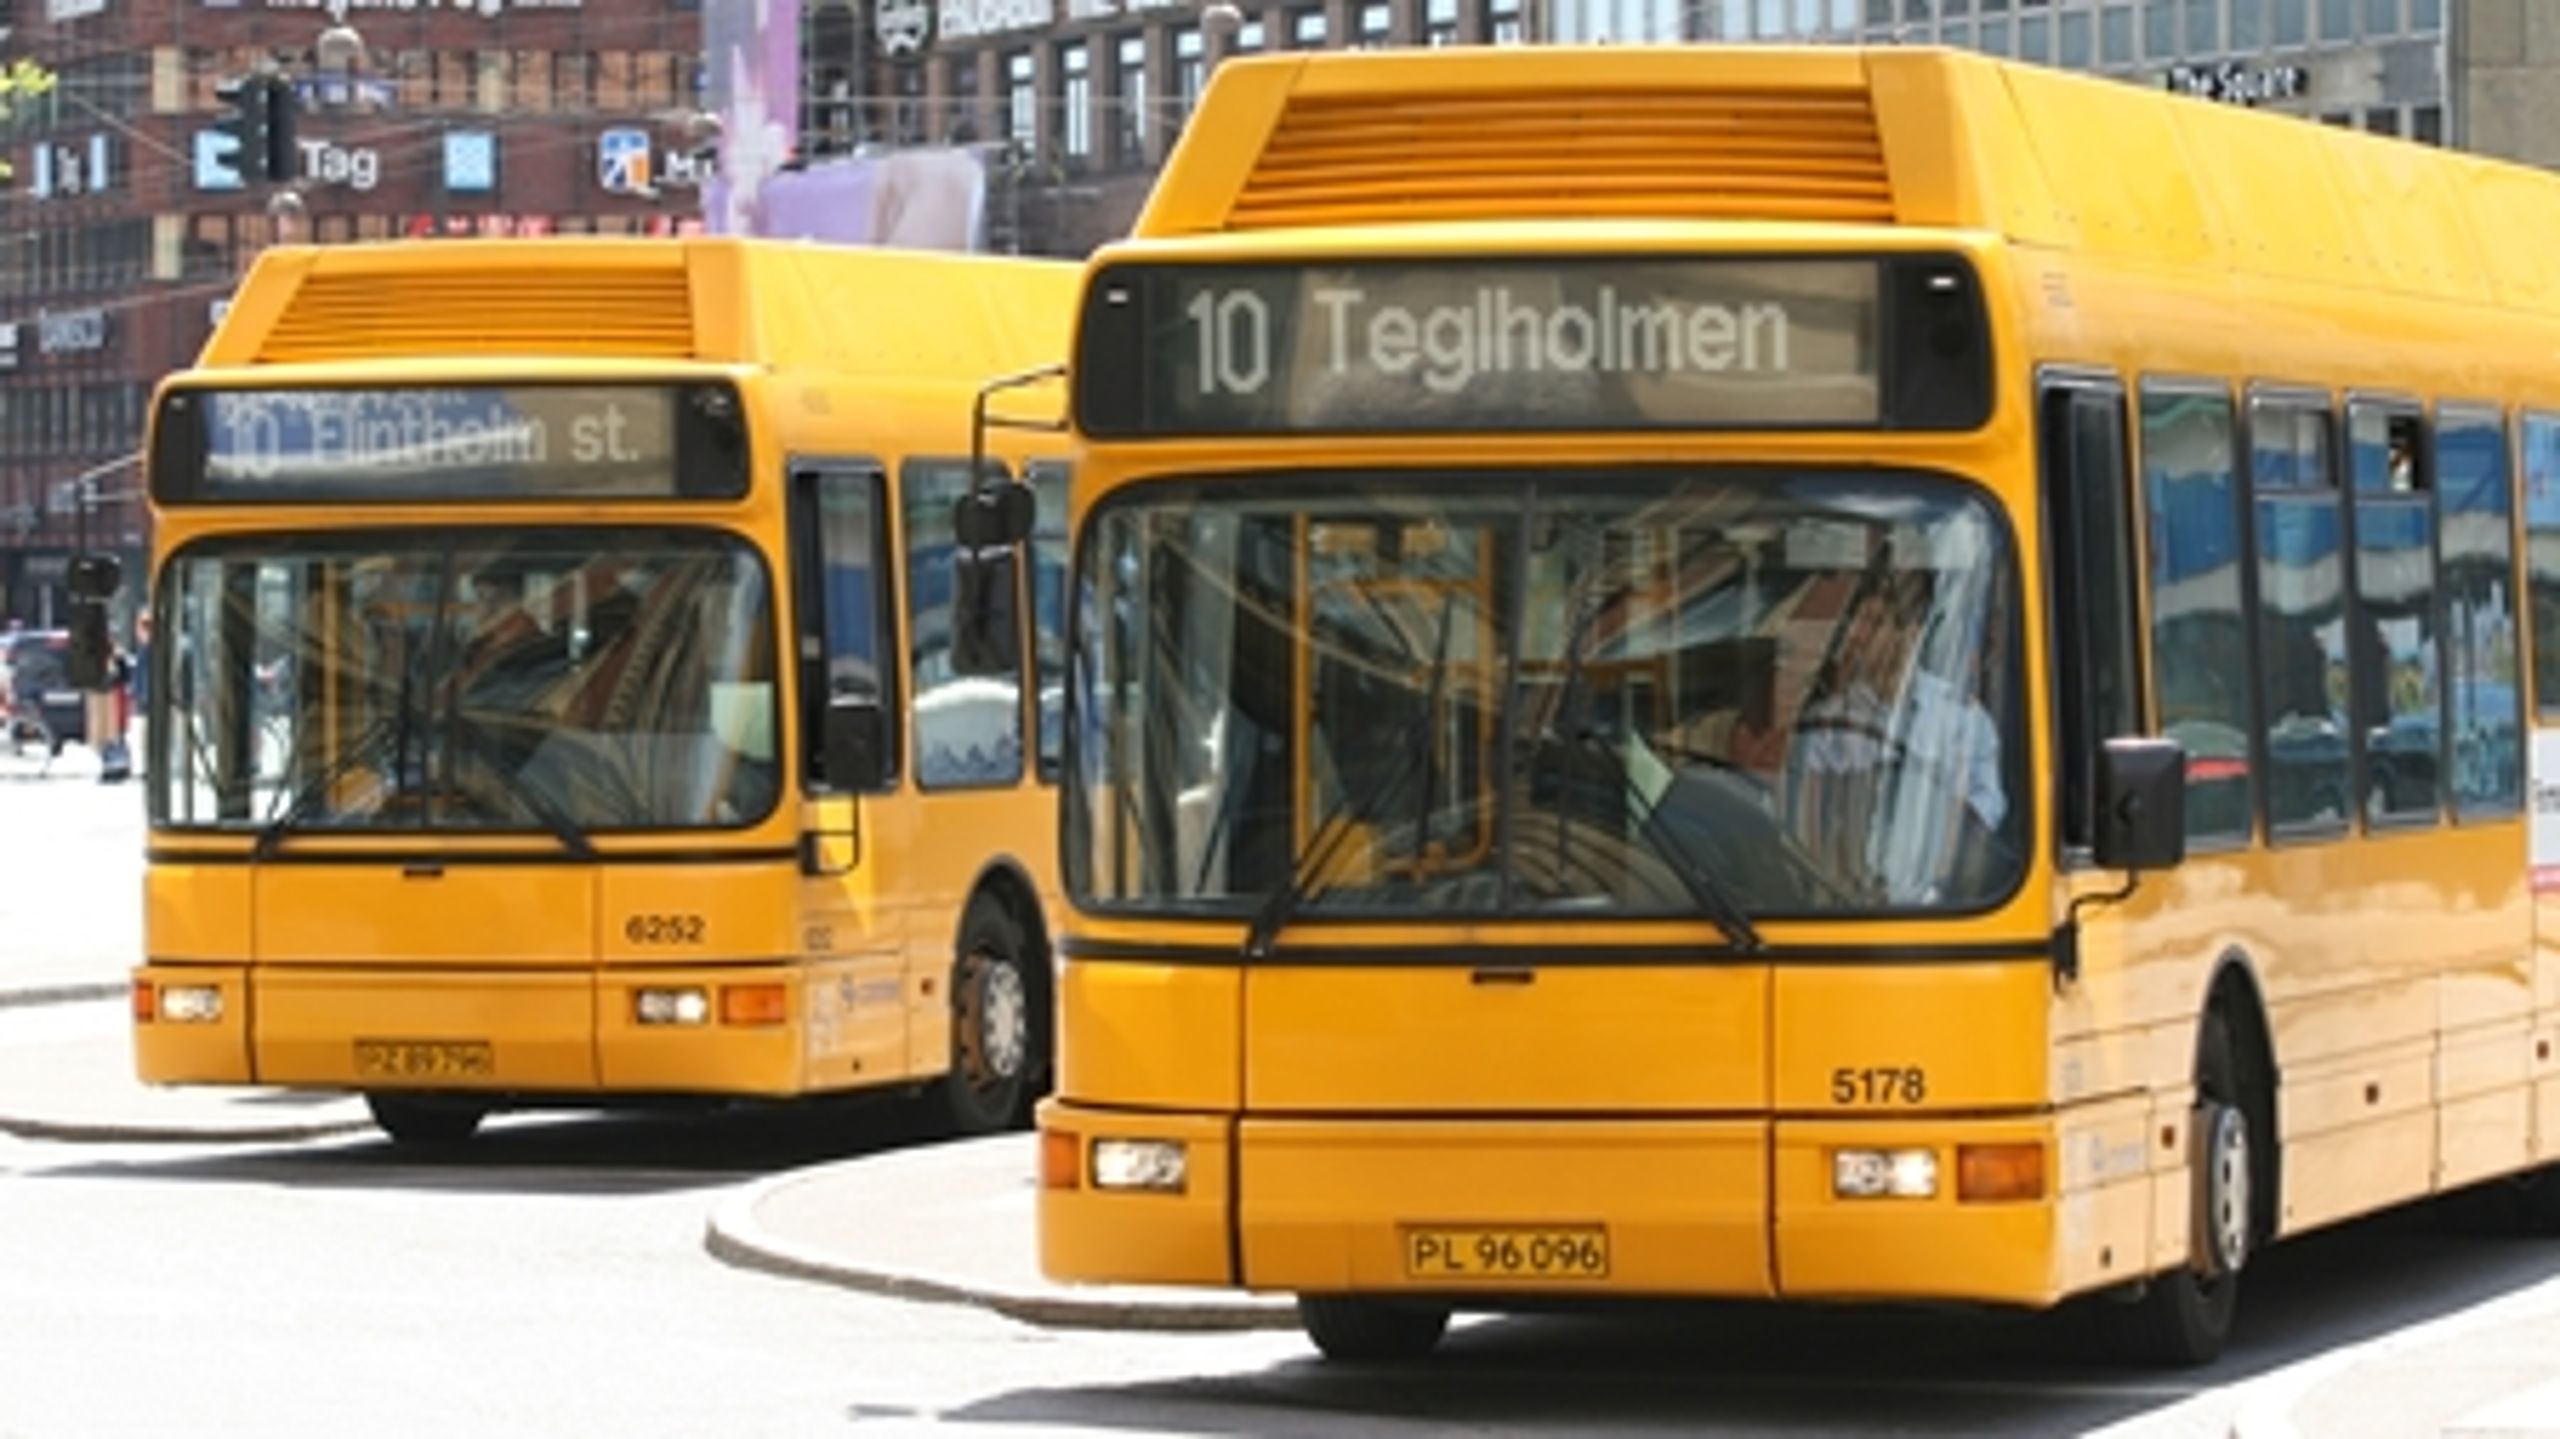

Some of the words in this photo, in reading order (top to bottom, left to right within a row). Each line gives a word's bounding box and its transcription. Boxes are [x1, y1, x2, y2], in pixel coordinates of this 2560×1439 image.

[297, 139, 379, 189] Tag
[1188, 289, 1270, 394] 10
[1312, 286, 1790, 393] Teglholmen
[569, 403, 640, 464] st.
[624, 913, 706, 945] 6252
[1831, 1066, 1926, 1104] 5178
[1415, 1237, 1464, 1270] PL
[1473, 1236, 1524, 1270] 96
[1529, 1236, 1602, 1270] 096
